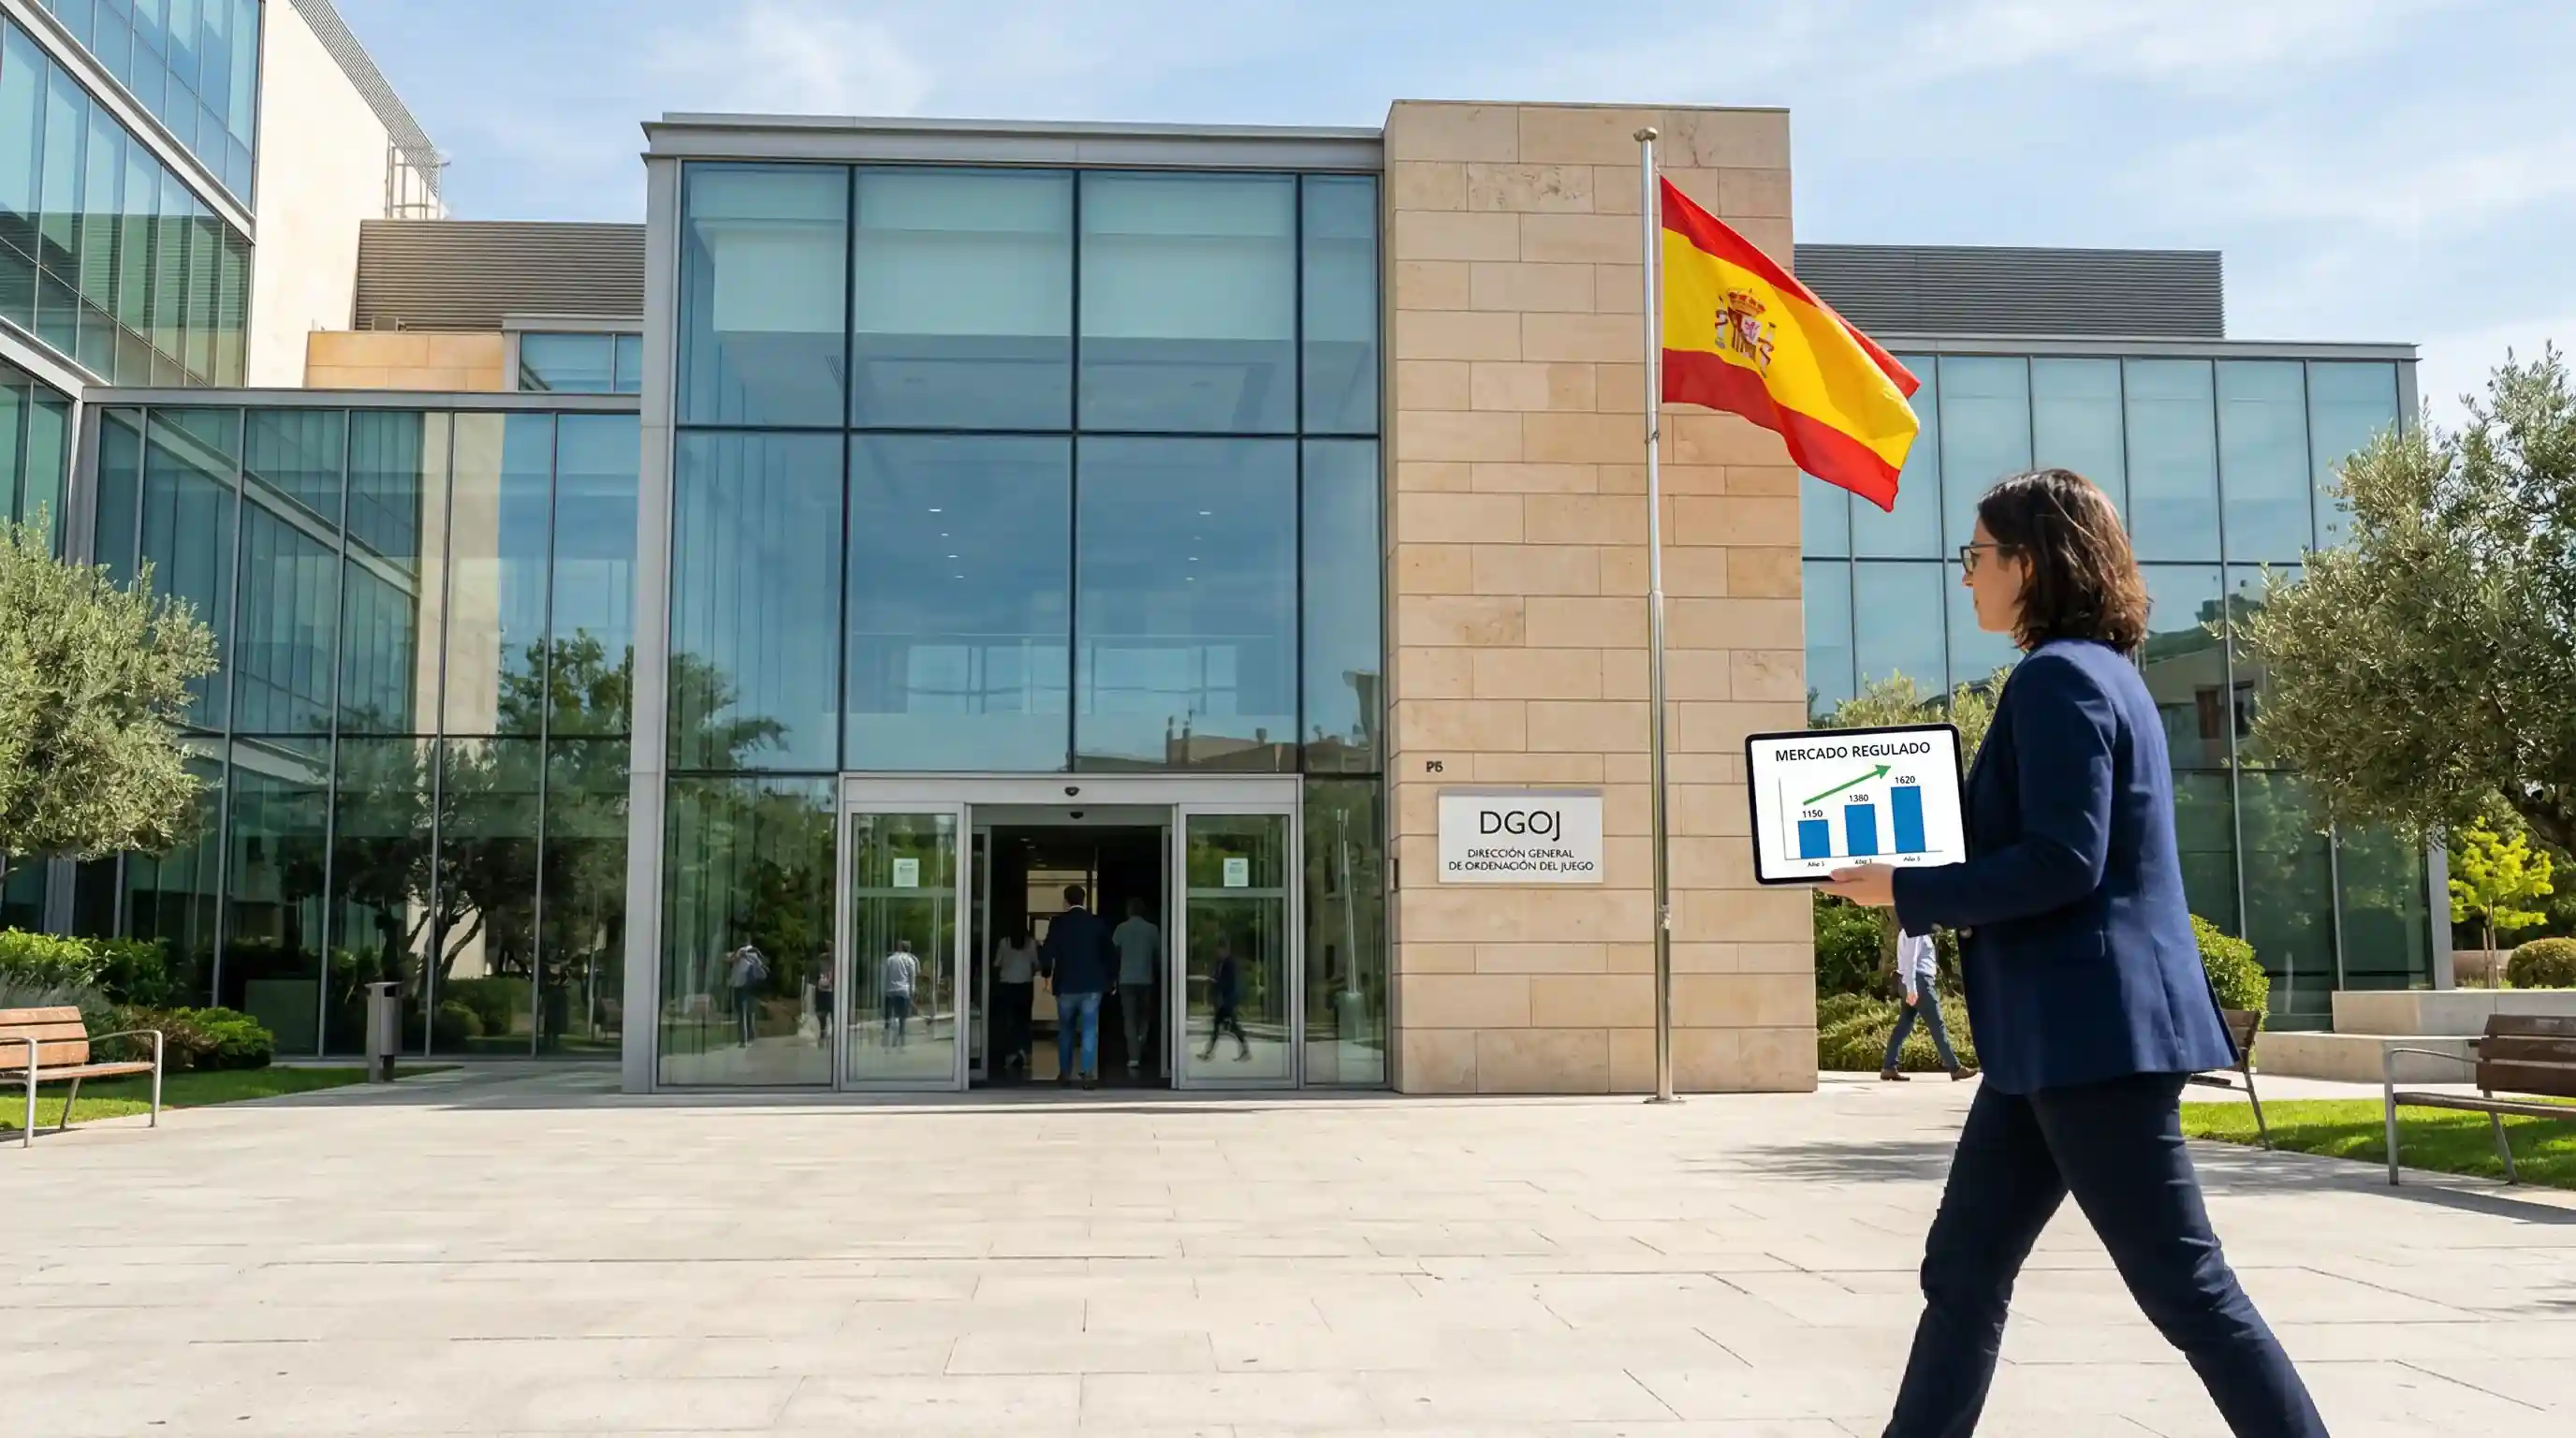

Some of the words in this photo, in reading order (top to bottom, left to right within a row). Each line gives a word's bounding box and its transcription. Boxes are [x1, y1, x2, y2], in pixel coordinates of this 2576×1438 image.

[1775, 746, 1848, 762] MERCADO
[1852, 741, 1931, 757] REGULADO
[1895, 775, 1916, 785] 1620
[1849, 794, 1869, 803] 1380
[1802, 809, 1823, 818] 1150
[1480, 811, 1560, 842] DGOJ
[1467, 846, 1526, 858] DIRECCIÓN
[1528, 848, 1574, 858] GENERAL
[1448, 861, 1462, 871] DE
[1465, 859, 1537, 871] ORDENACIÓN
[1540, 861, 1559, 871] DEL
[1560, 861, 1594, 873] JUEGO
